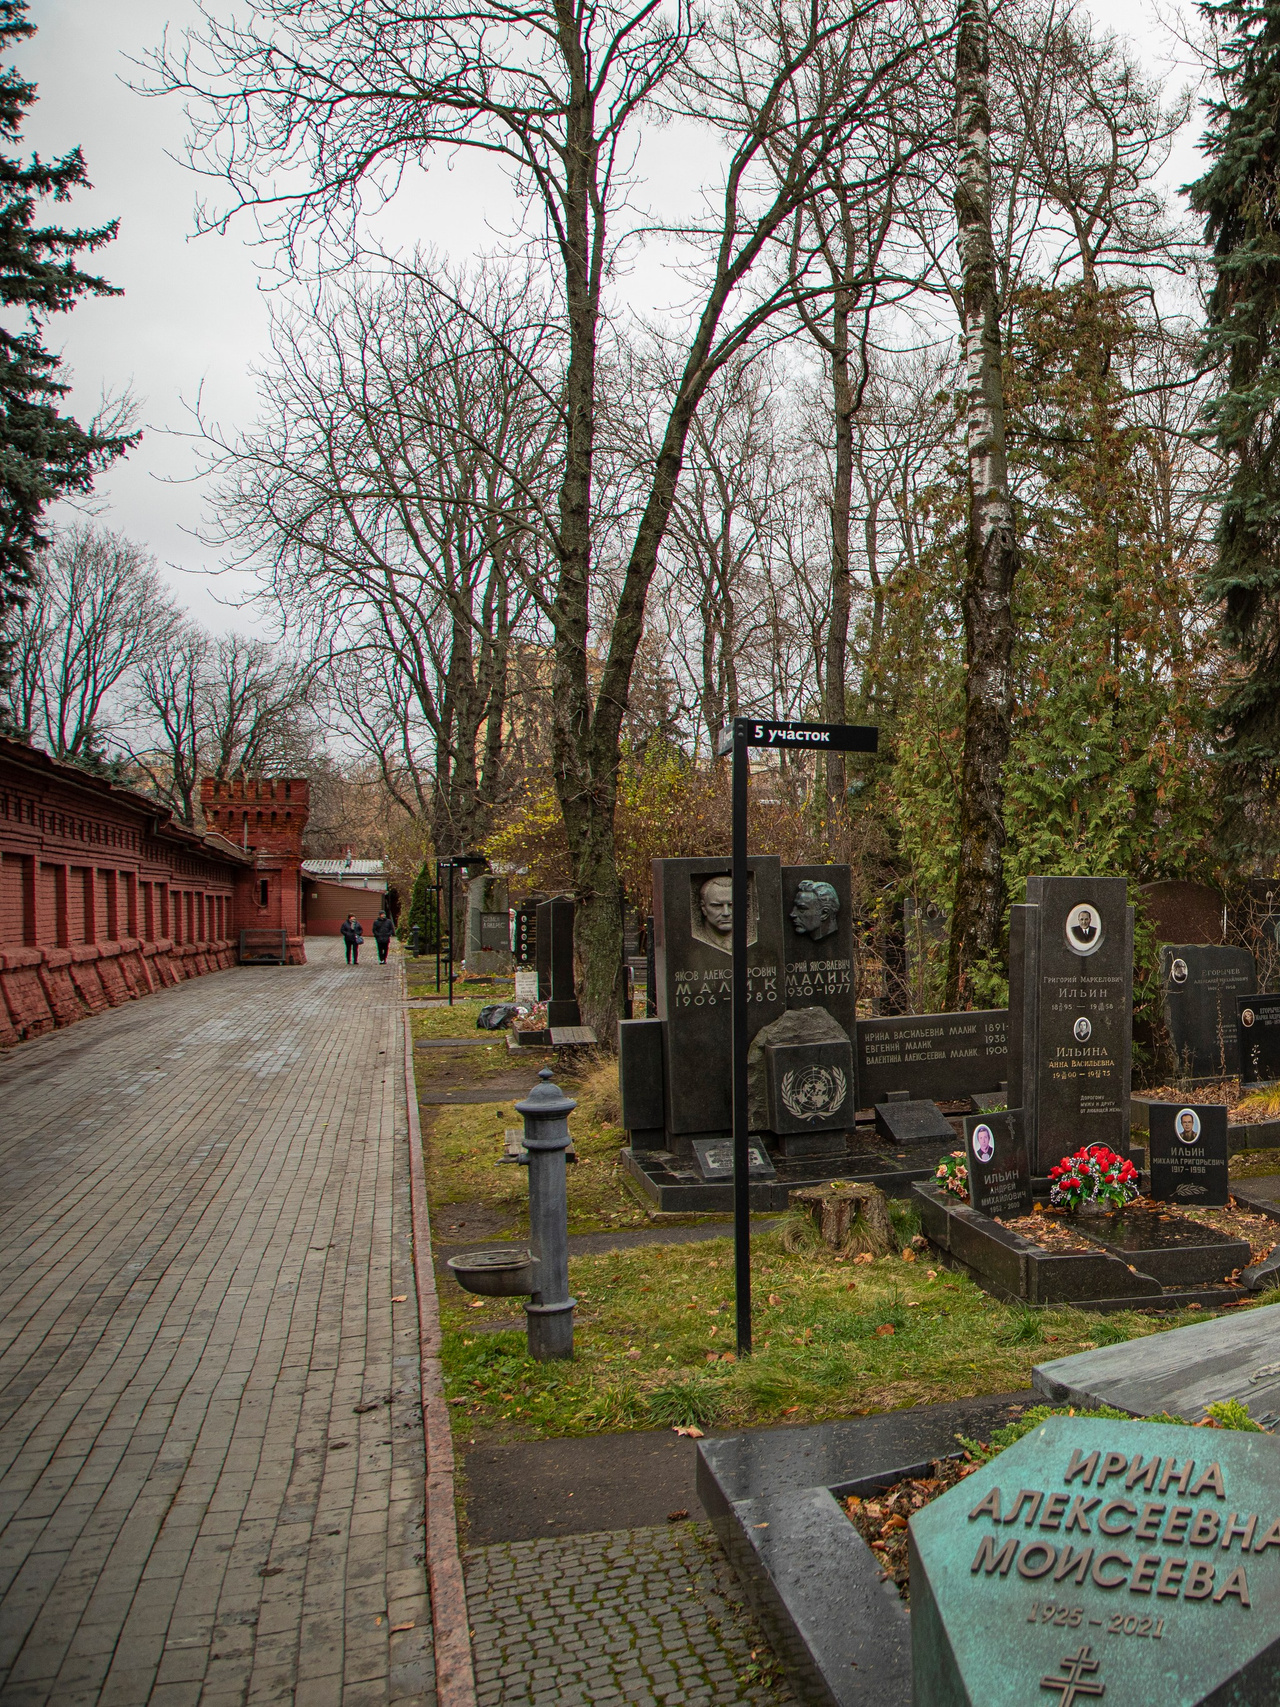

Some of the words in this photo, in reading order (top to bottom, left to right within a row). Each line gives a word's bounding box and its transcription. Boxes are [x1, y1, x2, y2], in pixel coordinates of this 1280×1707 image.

[754, 725, 764, 738] 5
[809, 958, 851, 972] ЯКОВЛЕВИЧ
[1201, 968, 1241, 976] ЕГОРЫЧЕВ
[674, 970, 699, 982] ЯКОВ
[703, 966, 777, 980] АЛЕКСРОВИЧ
[785, 971, 851, 987] МАЛИК
[1059, 988, 1107, 998] ИЛЬИН
[675, 994, 717, 1007] 1906
[864, 1032, 890, 1042] ИРИНА
[893, 1027, 945, 1039] ВАСИЛЬЕВНА
[949, 1025, 977, 1035] МАЛИК
[865, 1042, 900, 1054] ЕВГЕНИЙ
[905, 1040, 932, 1051] МАЛИК
[1056, 1046, 1109, 1057] ИЛЬИНА
[866, 1055, 902, 1065] ВАЛЕНТИНА
[904, 1051, 947, 1062] АЛЕКСЕЕВНА
[950, 1049, 978, 1058] МАЛИК
[1048, 1060, 1069, 1068] АННА
[1071, 1059, 1115, 1068] ВАСИЛЬЕВНА
[1170, 1147, 1205, 1157] ИЛЬИН
[1152, 1157, 1179, 1165] МИХАИЛ
[1180, 1158, 1224, 1166] ГРИГОРЬЕВИЧ
[984, 1169, 1020, 1184] ИЛЬИН
[990, 1182, 1016, 1194] АНДРЕЙ
[981, 1191, 1027, 1206] МИХАЙЛОВИЧ
[1063, 1448, 1227, 1500] ИРИНА
[970, 1535, 1252, 1607] МОИСЕЕВА
[1026, 1601, 1085, 1628] 1925
[1107, 1614, 1166, 1640] 2021
